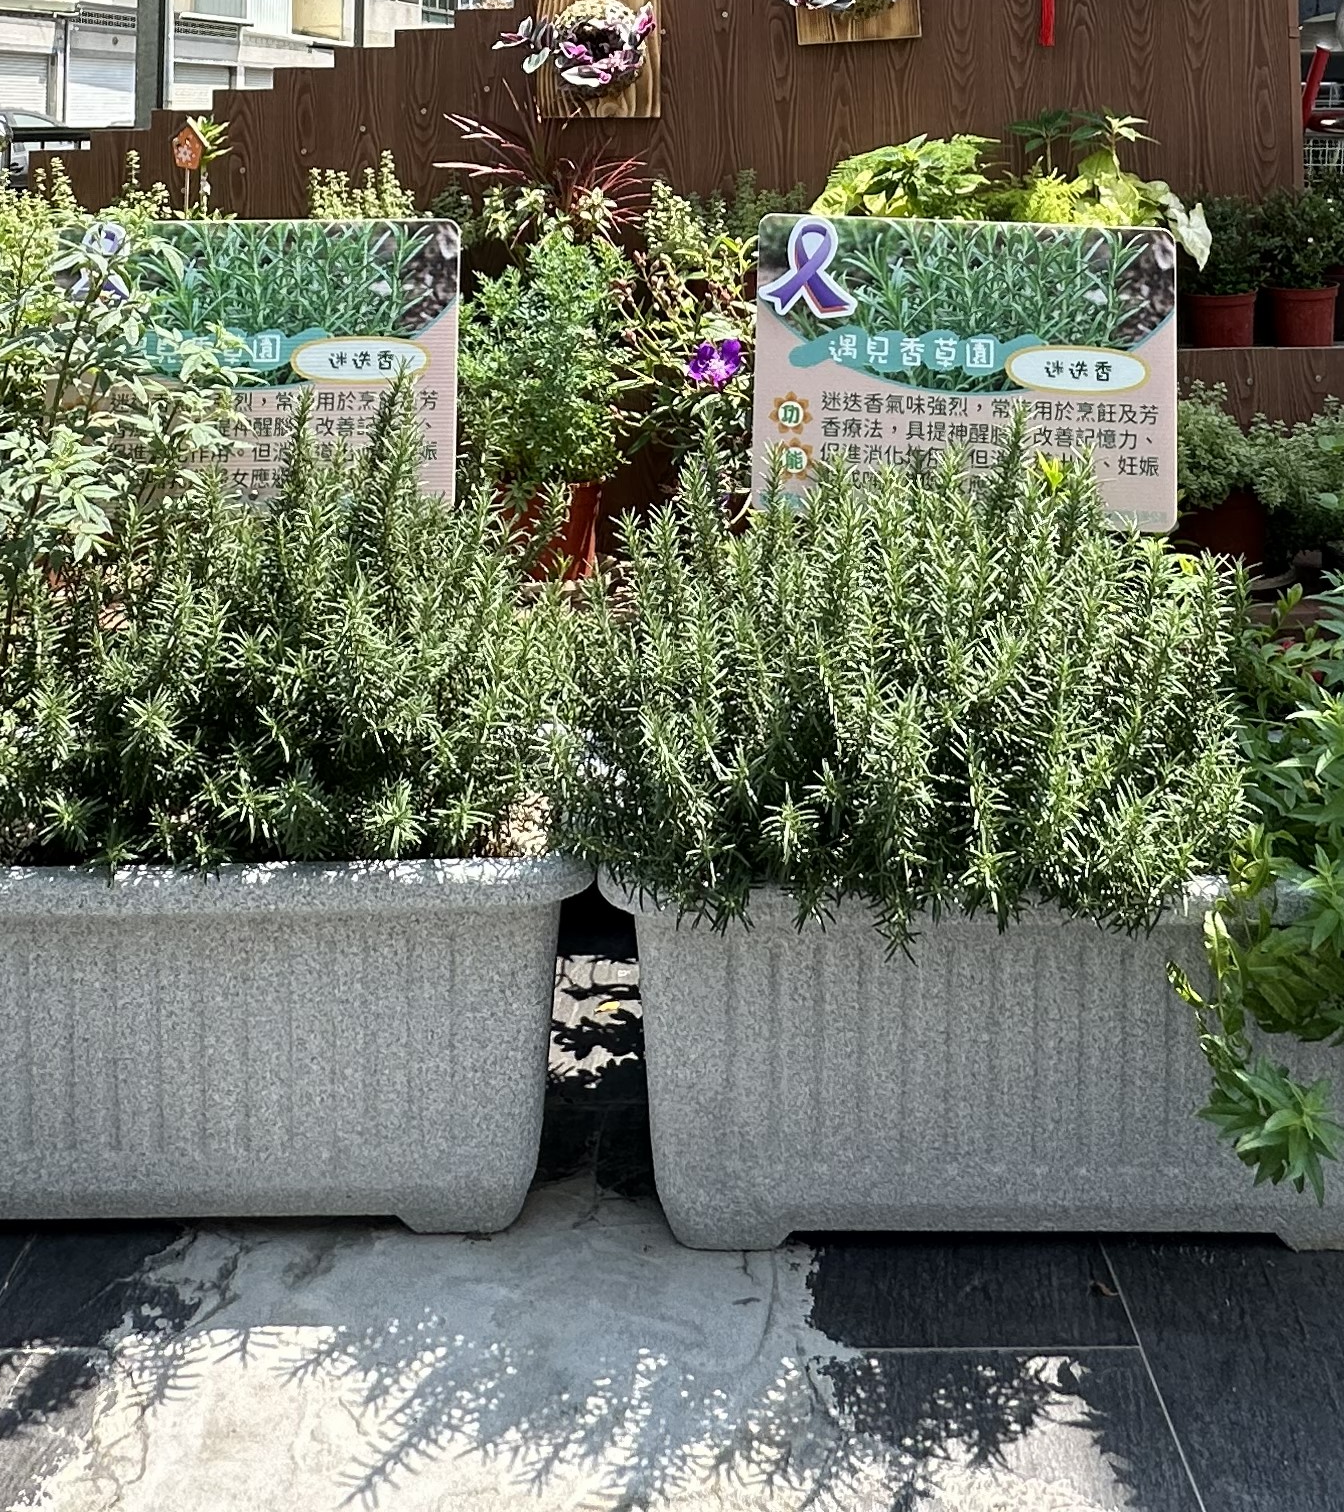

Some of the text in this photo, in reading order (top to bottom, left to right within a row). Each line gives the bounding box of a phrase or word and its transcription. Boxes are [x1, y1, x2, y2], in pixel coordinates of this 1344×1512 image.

[329, 350, 394, 370] 迷迭香
[828, 334, 995, 369] 遇見香草園
[1044, 360, 1112, 382] 迷迭香
[781, 404, 800, 424] 功
